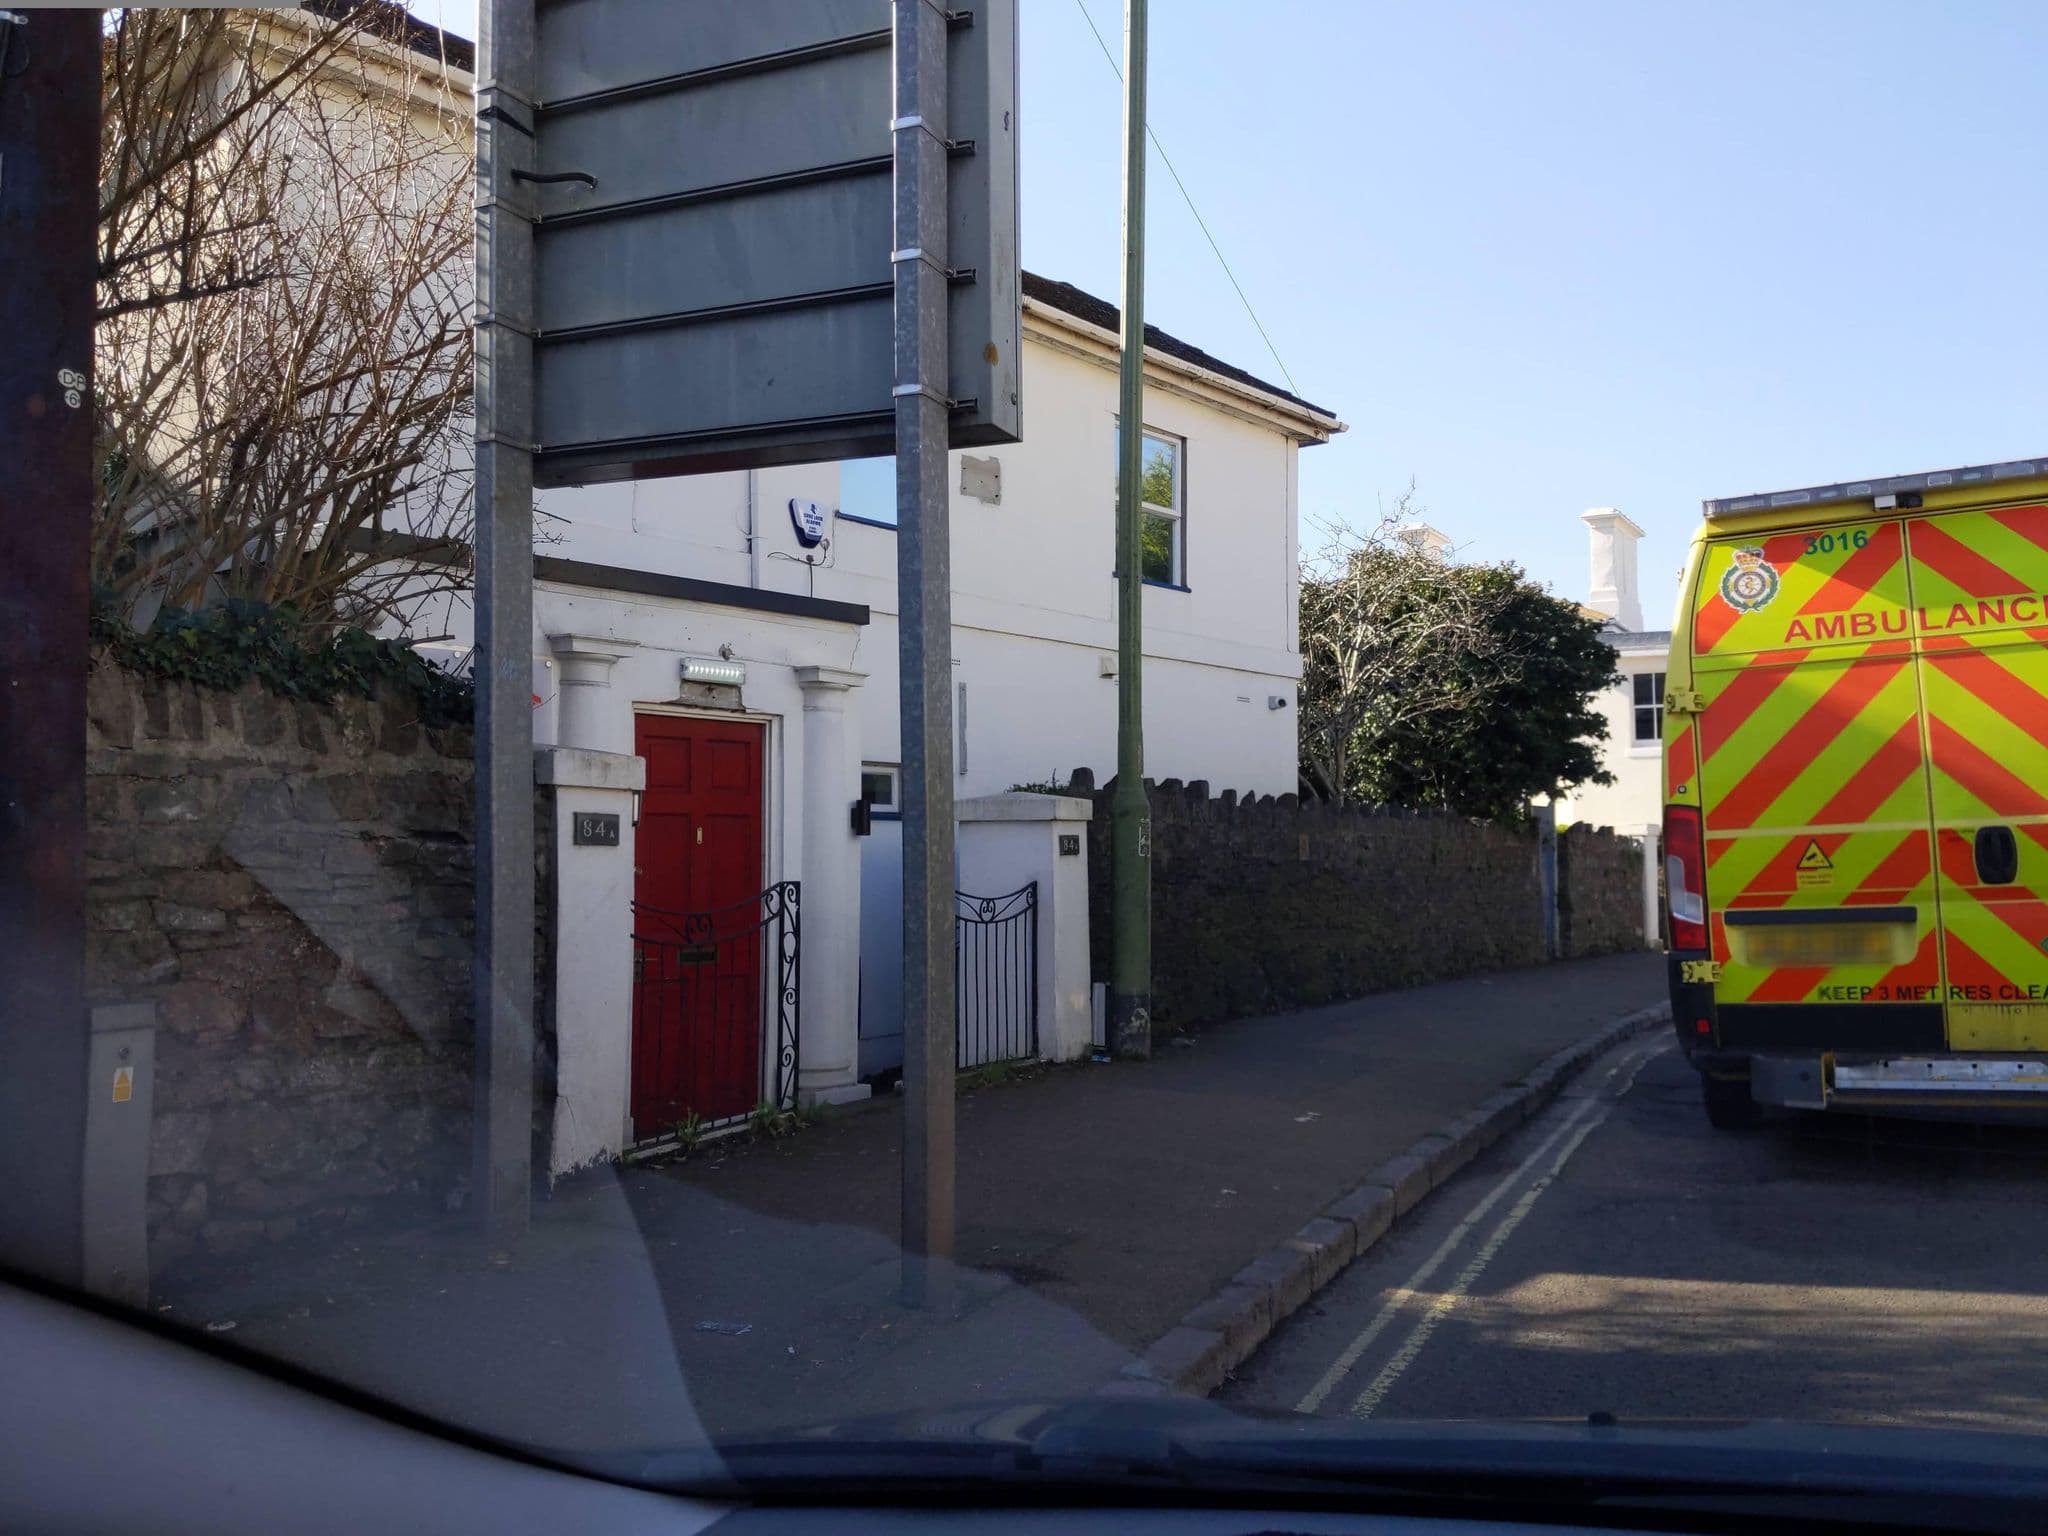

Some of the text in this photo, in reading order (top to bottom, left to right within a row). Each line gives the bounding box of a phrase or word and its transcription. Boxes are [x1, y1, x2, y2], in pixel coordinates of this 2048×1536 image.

[61, 370, 86, 390] DP
[1803, 530, 1869, 555] 3016
[1784, 594, 2048, 643] AMBULANC
[1818, 984, 1872, 1000] KEEP
[1879, 984, 1889, 1000] 3
